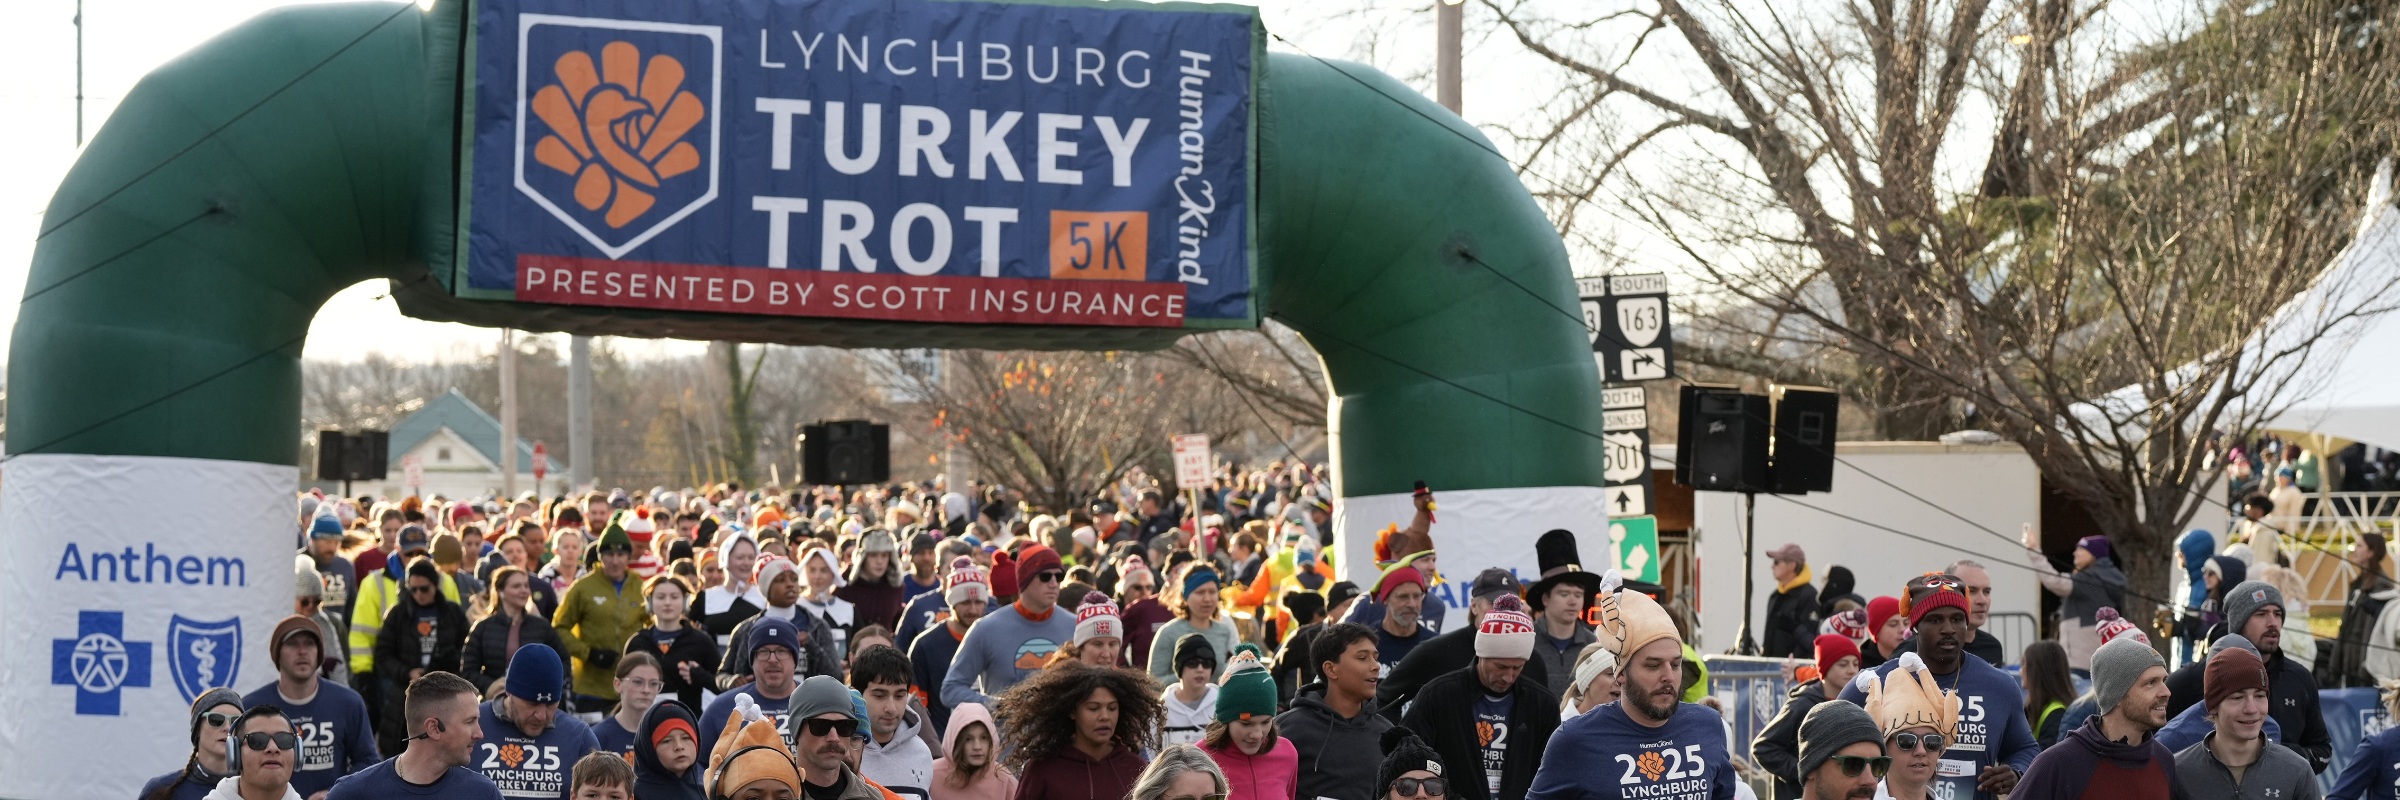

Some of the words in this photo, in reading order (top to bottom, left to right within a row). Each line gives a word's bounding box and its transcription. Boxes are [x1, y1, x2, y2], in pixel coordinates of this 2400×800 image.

[759, 28, 1151, 88] LYNCHBURG
[755, 97, 1151, 187] TURKEY
[752, 196, 1019, 277] TROT
[1069, 220, 1128, 270] 5K
[526, 267, 755, 303] PRESENTED
[769, 281, 815, 306] BY
[832, 284, 951, 311] SCOTT
[969, 288, 1185, 318] INSURANCE
[1614, 278, 1664, 292] SOUTH
[1624, 306, 1657, 331] 163
[1602, 391, 1642, 405] OUTH
[1604, 413, 1644, 426] SINESS
[55, 542, 245, 587] Anthem
[1077, 605, 1120, 622] TURK
[1488, 622, 1530, 634] TRO
[1957, 734, 1986, 744] TROT
[481, 743, 561, 770] 225
[1614, 744, 1705, 785] 225
[494, 780, 528, 790] RKEY
[532, 782, 563, 792] TROT
[1622, 779, 1708, 799] LYNCHBURG
